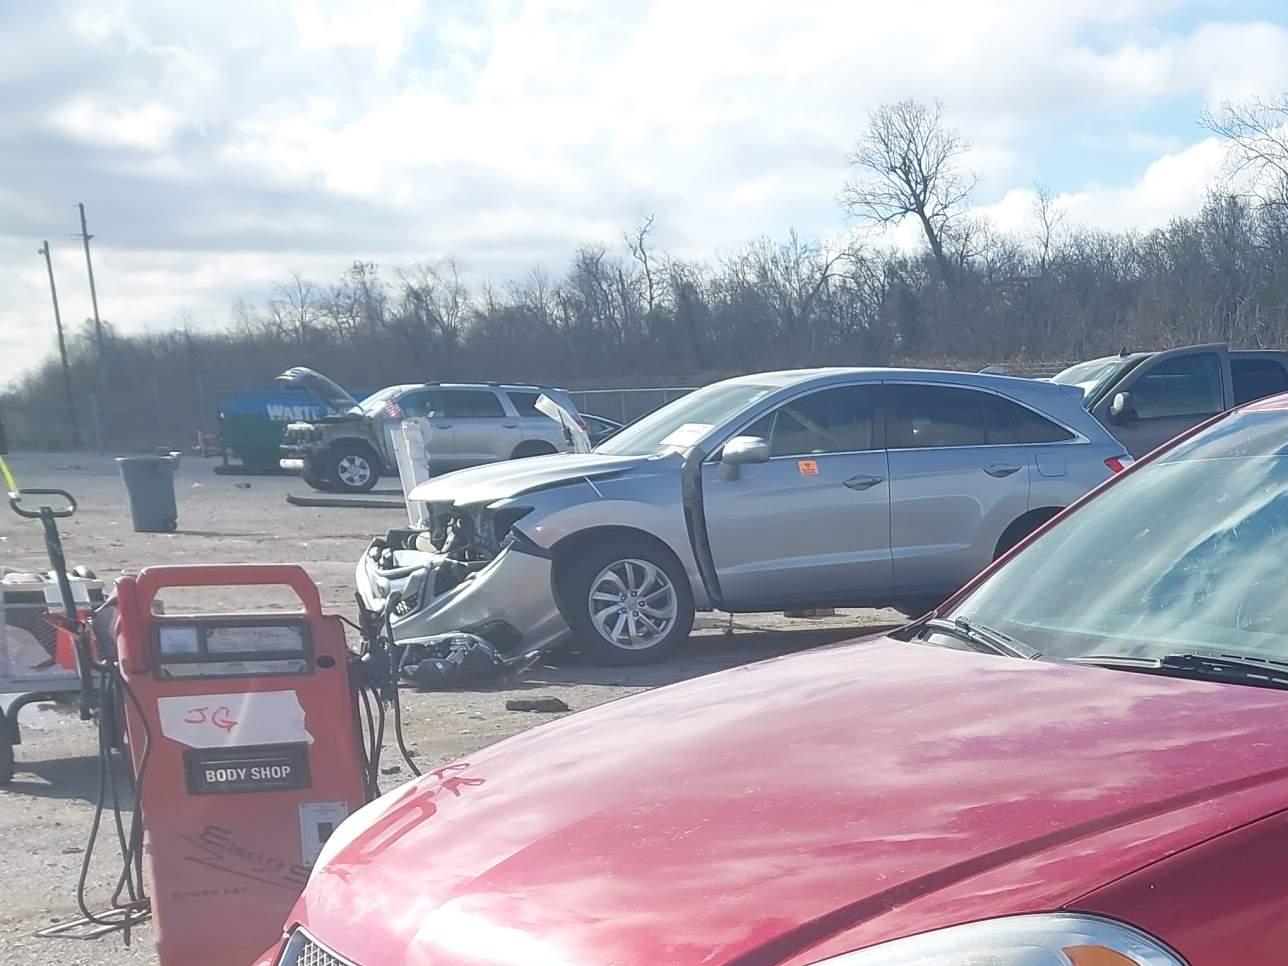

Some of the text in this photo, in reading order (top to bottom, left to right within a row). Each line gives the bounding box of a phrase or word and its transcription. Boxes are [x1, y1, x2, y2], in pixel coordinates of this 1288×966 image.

[184, 706, 239, 733] JG
[205, 765, 292, 783] BODY SHOP
